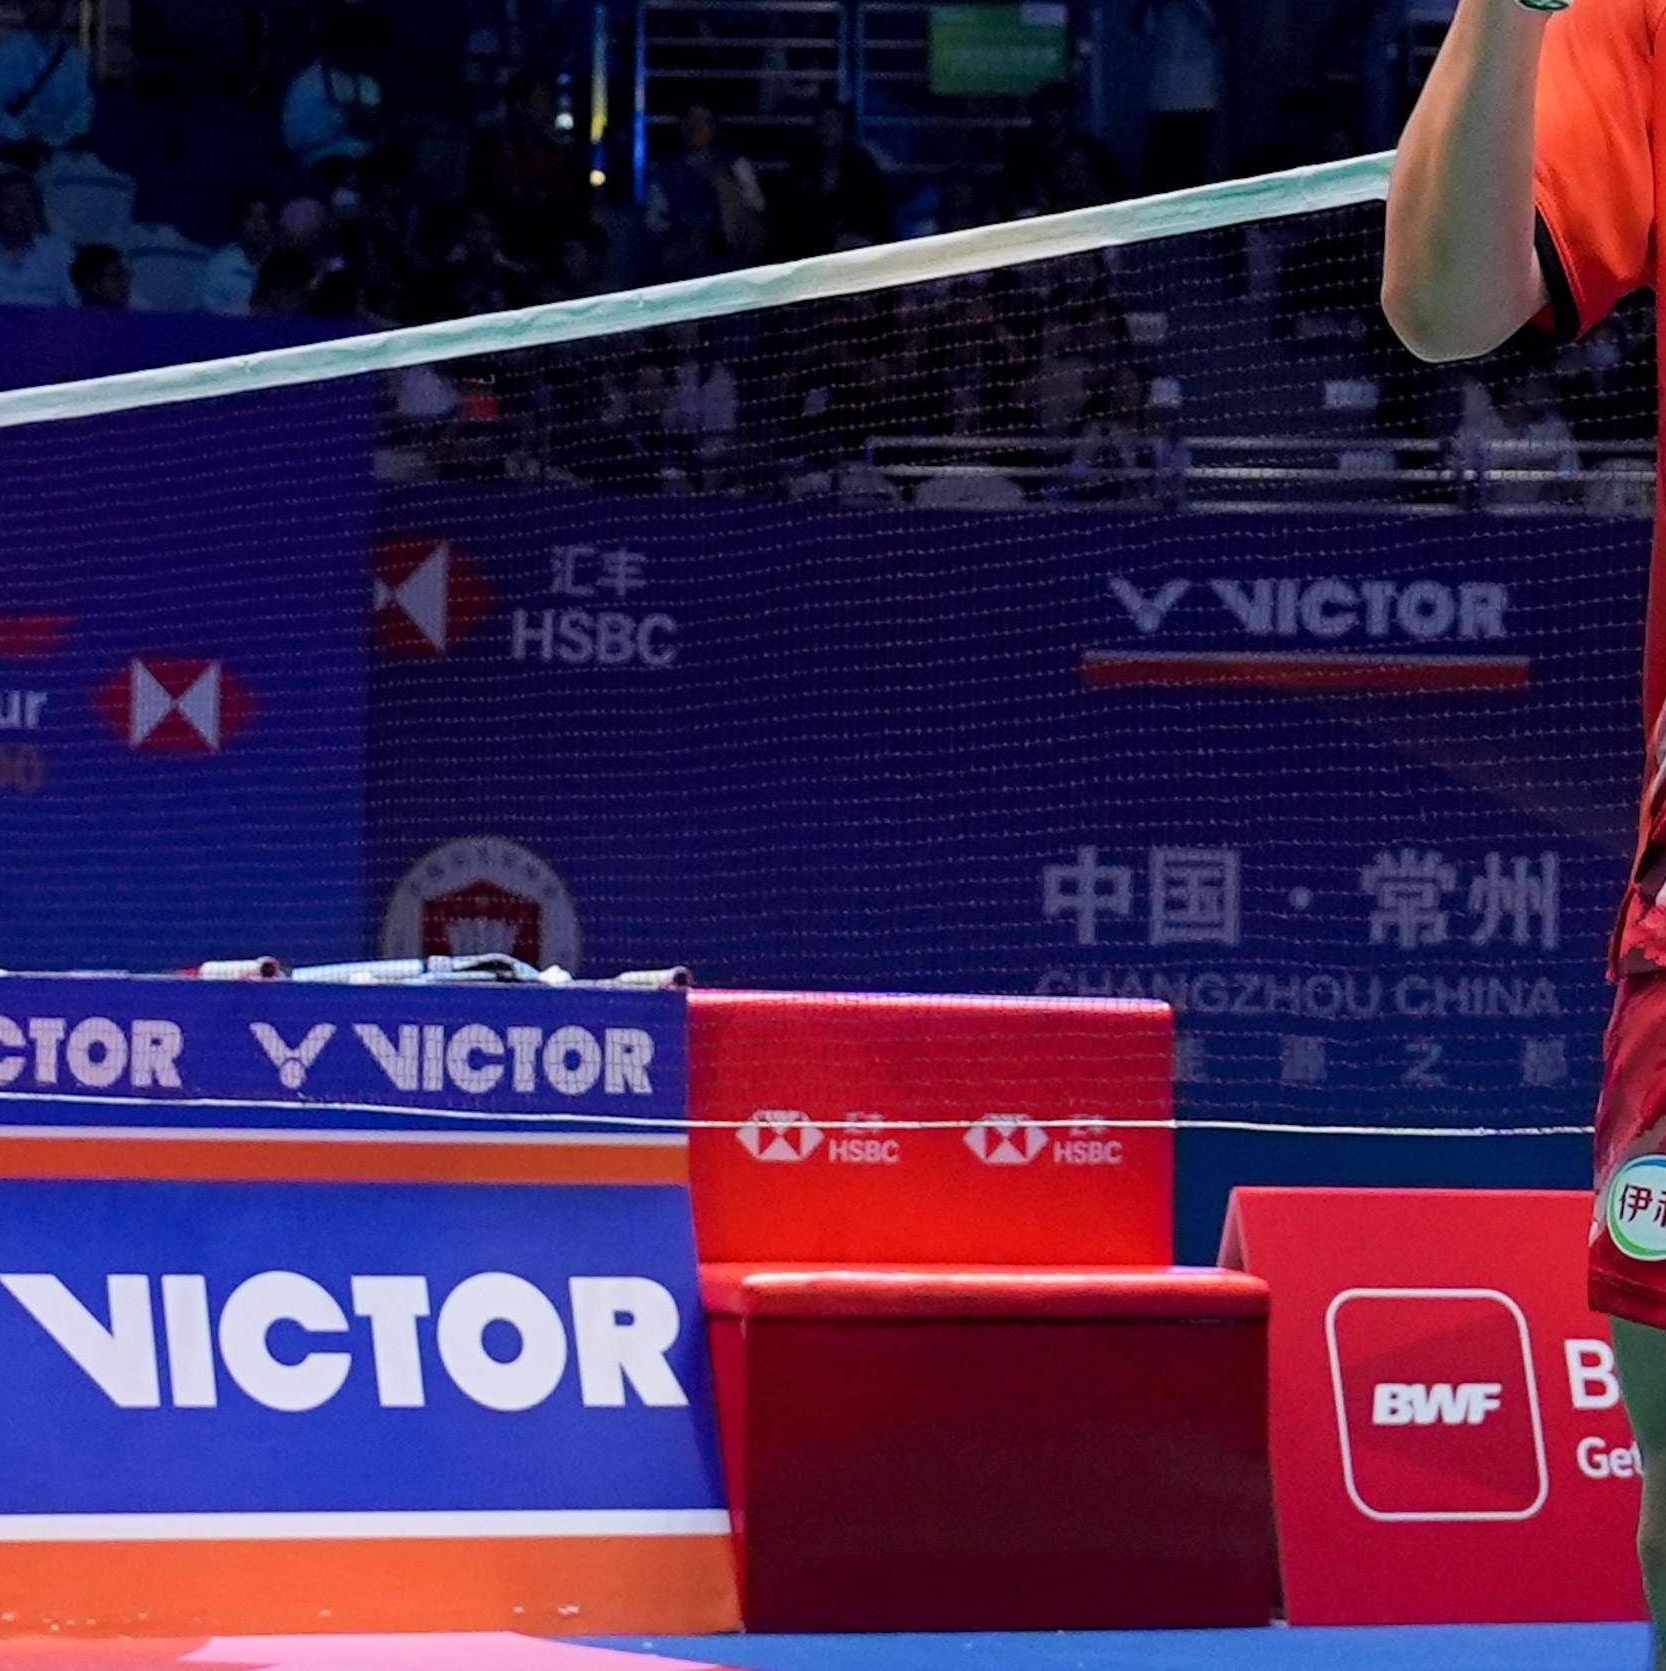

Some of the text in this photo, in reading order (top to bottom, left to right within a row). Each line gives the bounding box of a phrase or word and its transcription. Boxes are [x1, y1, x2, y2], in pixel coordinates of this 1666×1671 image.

[1212, 578, 1510, 640] VICTOR
[511, 607, 679, 668] HSBC
[1395, 975, 1562, 1016] CHINA
[354, 1023, 654, 1096] VICTOR
[829, 1139, 900, 1165] HSBC
[1053, 1140, 1124, 1165] HSBC
[1371, 1382, 1502, 1425] BWF
